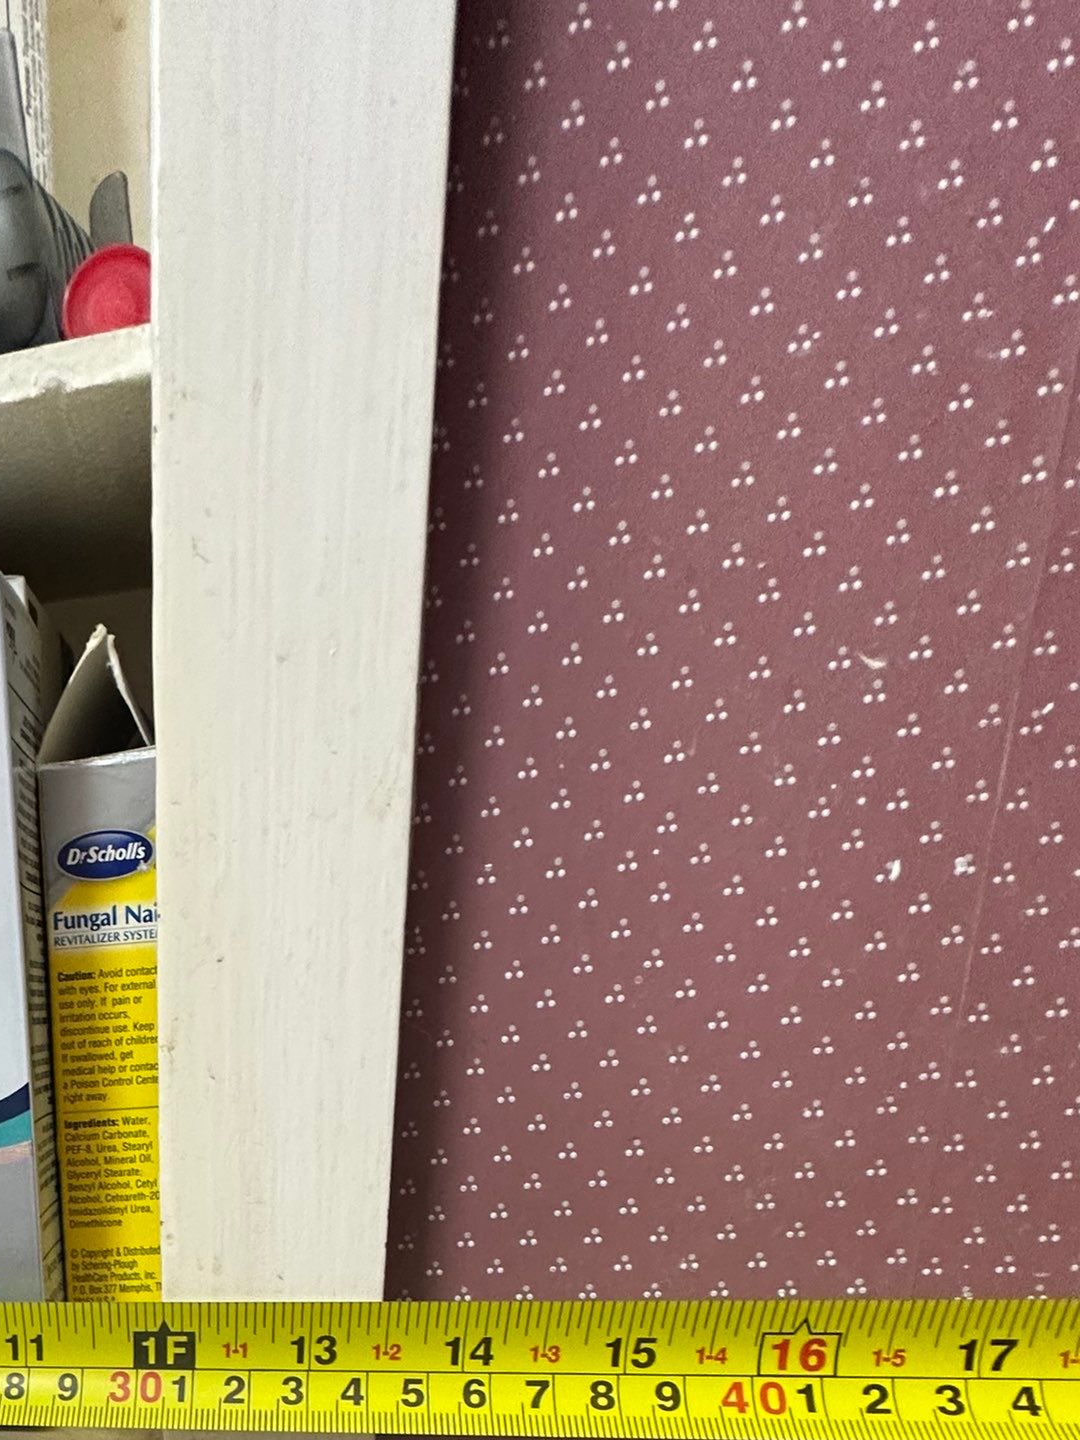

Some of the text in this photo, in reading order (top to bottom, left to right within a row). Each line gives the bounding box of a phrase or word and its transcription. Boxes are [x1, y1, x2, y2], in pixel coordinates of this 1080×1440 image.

[53, 906, 117, 931] Fungal
[54, 929, 158, 946] REVITALIZER SYSTE
[58, 972, 95, 982] Caution:
[98, 969, 123, 978] Avoid
[104, 982, 118, 992] For
[121, 980, 156, 991] external
[65, 1119, 119, 1130] Ingredients:
[69, 1218, 122, 1229] Dimethicone
[5, 1334, 44, 1361] 11
[140, 1335, 189, 1365] 1F
[290, 1334, 337, 1365] 13
[445, 1336, 494, 1367] 14
[605, 1337, 657, 1368] 15
[771, 1338, 828, 1372] 16
[959, 1338, 1019, 1372] 17
[3, 1372, 25, 1400] 8
[57, 1372, 78, 1401] 9
[109, 1371, 162, 1403] 30
[172, 1375, 186, 1403] 1
[223, 1375, 246, 1404] 2
[281, 1376, 304, 1405] 3
[340, 1377, 364, 1405] 4
[400, 1378, 425, 1408] 5
[462, 1379, 487, 1408] 6
[525, 1380, 551, 1409] 7
[589, 1381, 616, 1411] 8
[654, 1381, 681, 1411] 9
[721, 1382, 787, 1415] 40
[796, 1383, 817, 1413] 1
[862, 1384, 893, 1415] 2
[935, 1385, 966, 1416] 3
[1011, 1386, 1042, 1417] 4
